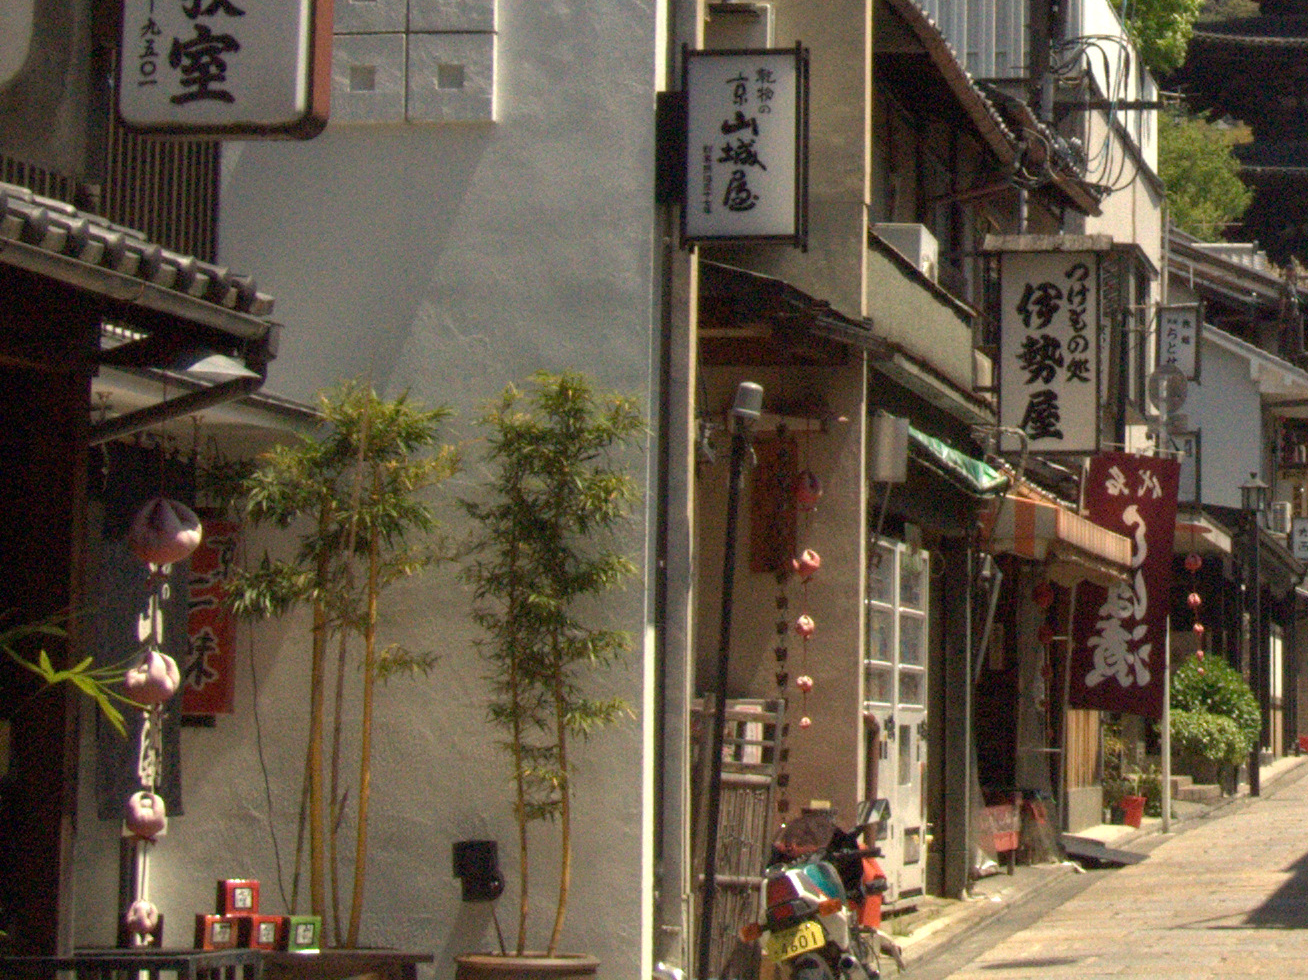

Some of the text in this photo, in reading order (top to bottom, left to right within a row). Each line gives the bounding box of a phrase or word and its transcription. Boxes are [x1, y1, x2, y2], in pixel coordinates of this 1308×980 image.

[1015, 281, 1065, 441] 伊勢屋
[1064, 262, 1092, 383] つけもの処
